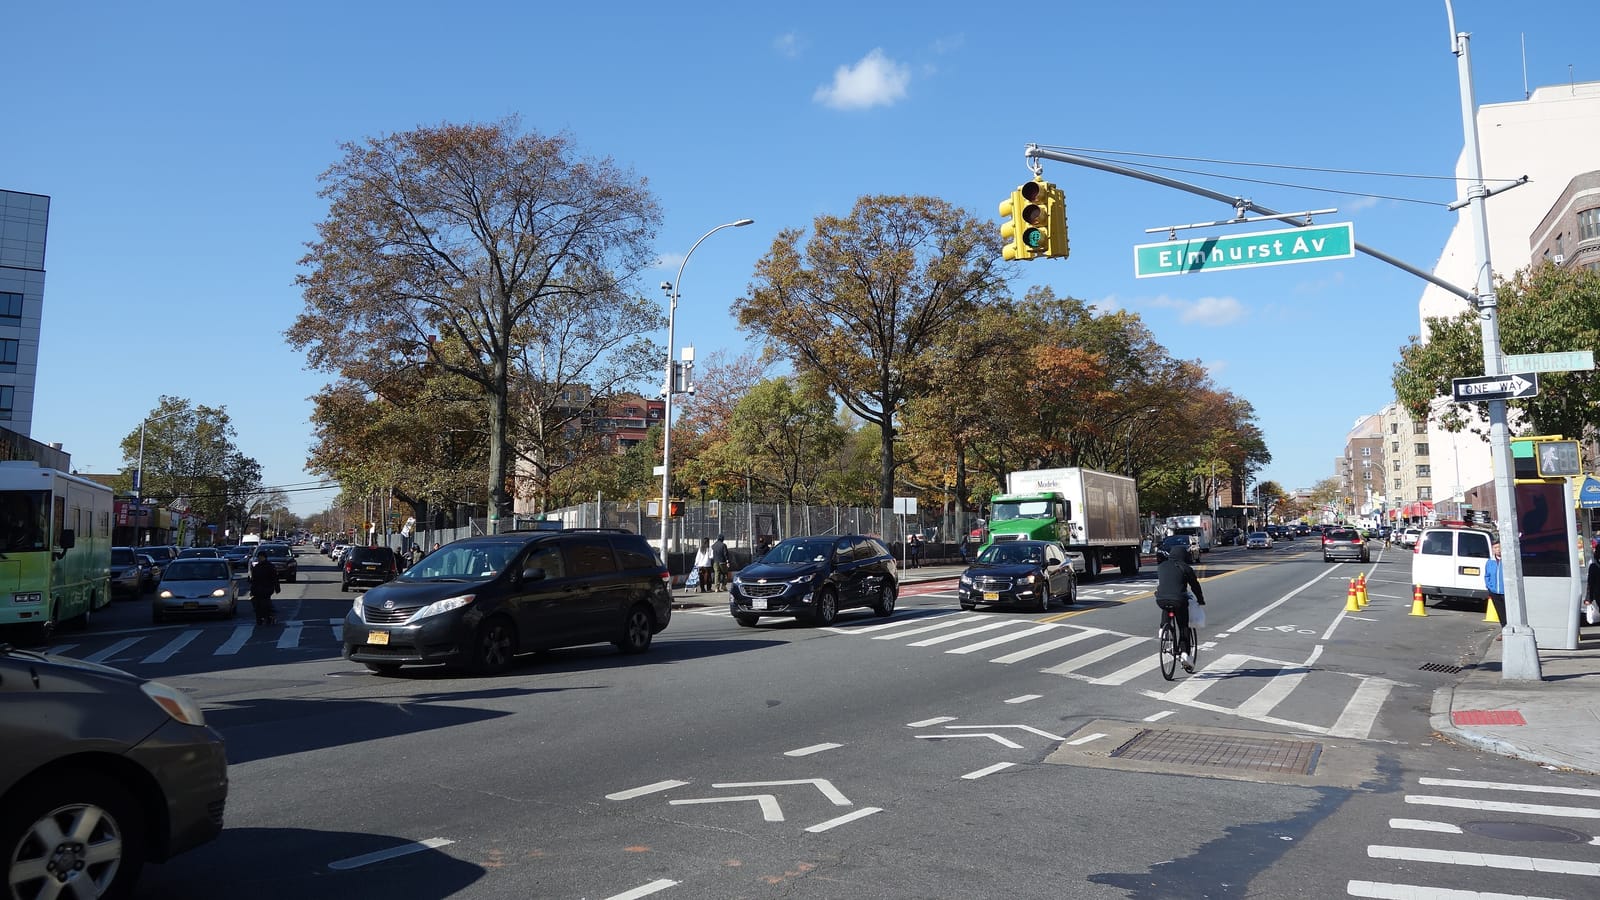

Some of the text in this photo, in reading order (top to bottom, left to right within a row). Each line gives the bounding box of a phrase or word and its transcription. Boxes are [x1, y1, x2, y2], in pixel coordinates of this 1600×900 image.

[1159, 235, 1326, 268] Elmhurst Av
[1508, 354, 1574, 371] ELMHURST
[1465, 380, 1524, 395] ONE WAY
